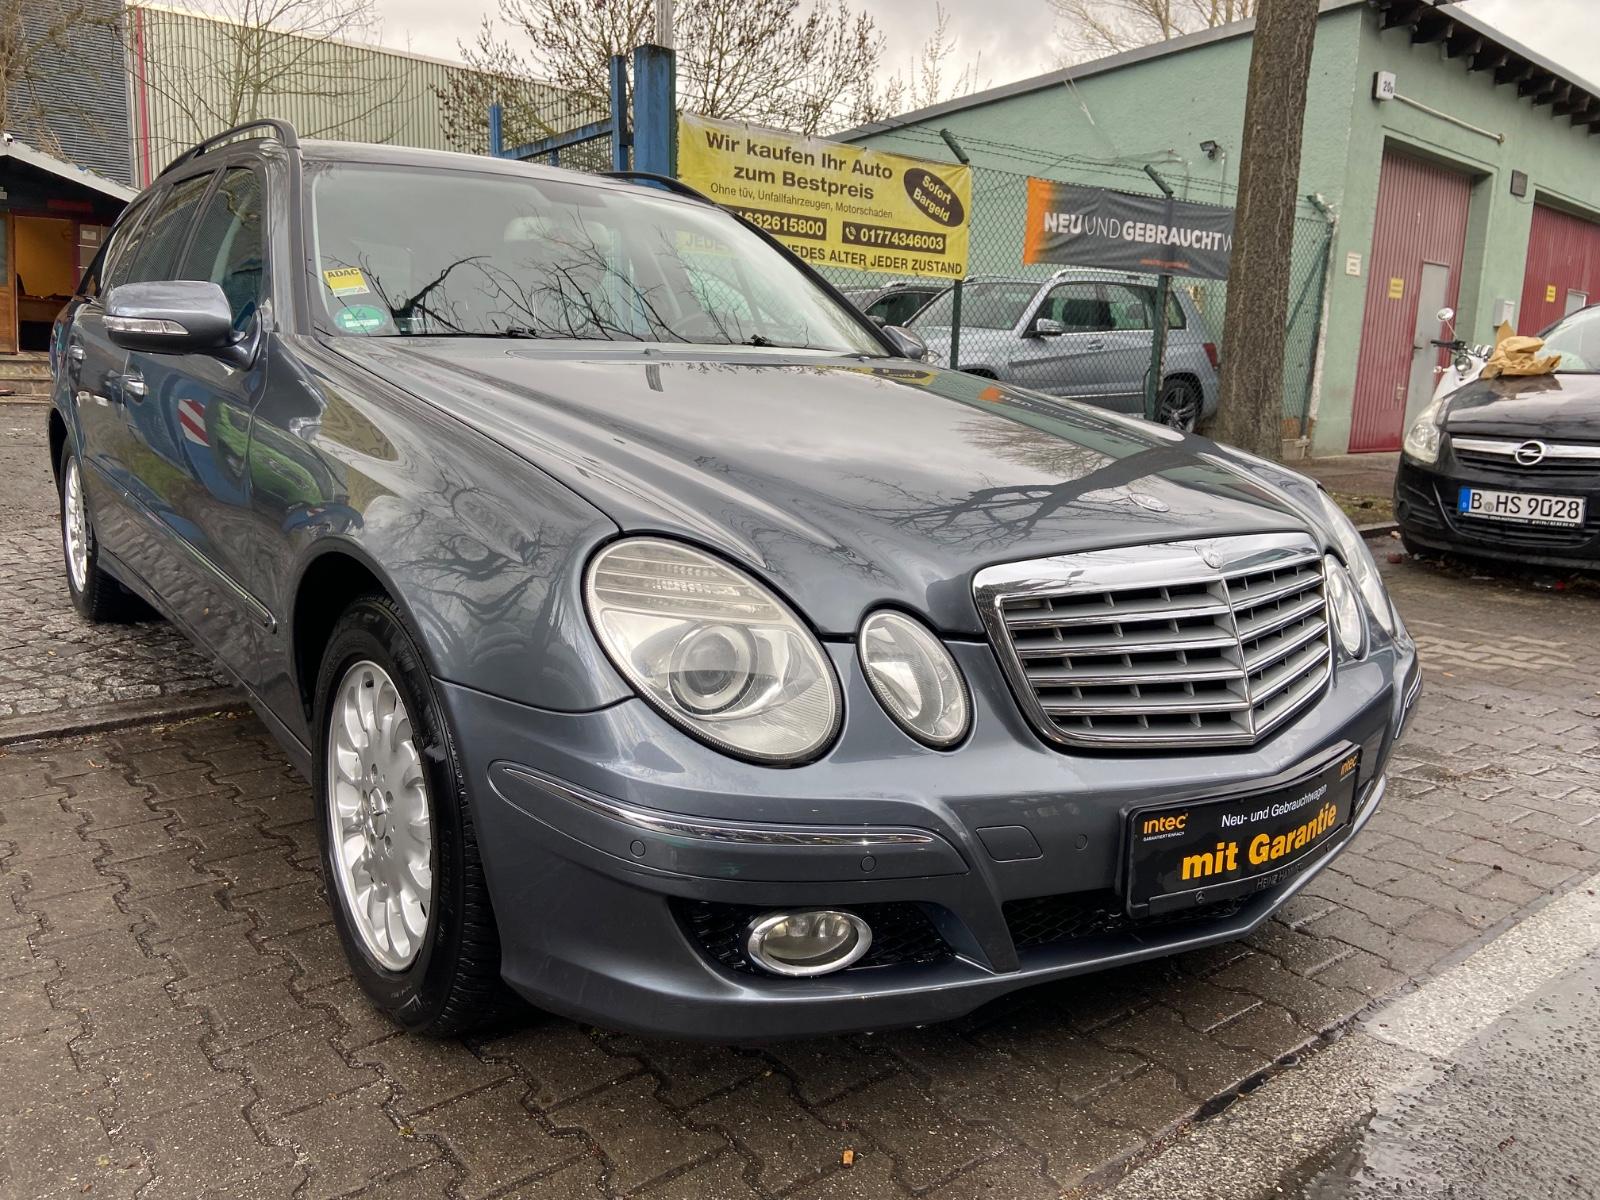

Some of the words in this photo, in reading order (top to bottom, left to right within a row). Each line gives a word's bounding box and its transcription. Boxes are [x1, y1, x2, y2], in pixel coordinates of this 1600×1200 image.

[705, 130, 740, 153] Wir
[746, 139, 815, 166] kaufen
[821, 152, 847, 171] Ihr
[851, 158, 893, 180] Auto
[733, 165, 776, 185] zum
[782, 170, 875, 200] Bestpreis
[921, 174, 953, 205] Sofort
[710, 182, 737, 196] Ohne
[757, 190, 834, 211] Unfallfahrzeugen,
[835, 202, 893, 219] Motorschaden
[912, 187, 950, 223] Bargeld
[860, 228, 944, 250] 01774346003
[327, 268, 359, 279] ADAC
[829, 249, 867, 266] ALTER
[870, 255, 908, 270] JEDER
[911, 259, 962, 275] ZUSTAND
[1471, 492, 1482, 510] B
[1495, 495, 1521, 514] HS
[1527, 498, 1580, 520] 9028
[1221, 812, 1248, 828] Neu-
[1250, 806, 1269, 823] und
[1271, 783, 1328, 817] Gebrauchtwagen
[1181, 841, 1239, 881] mit
[1248, 801, 1337, 865] Garantie
